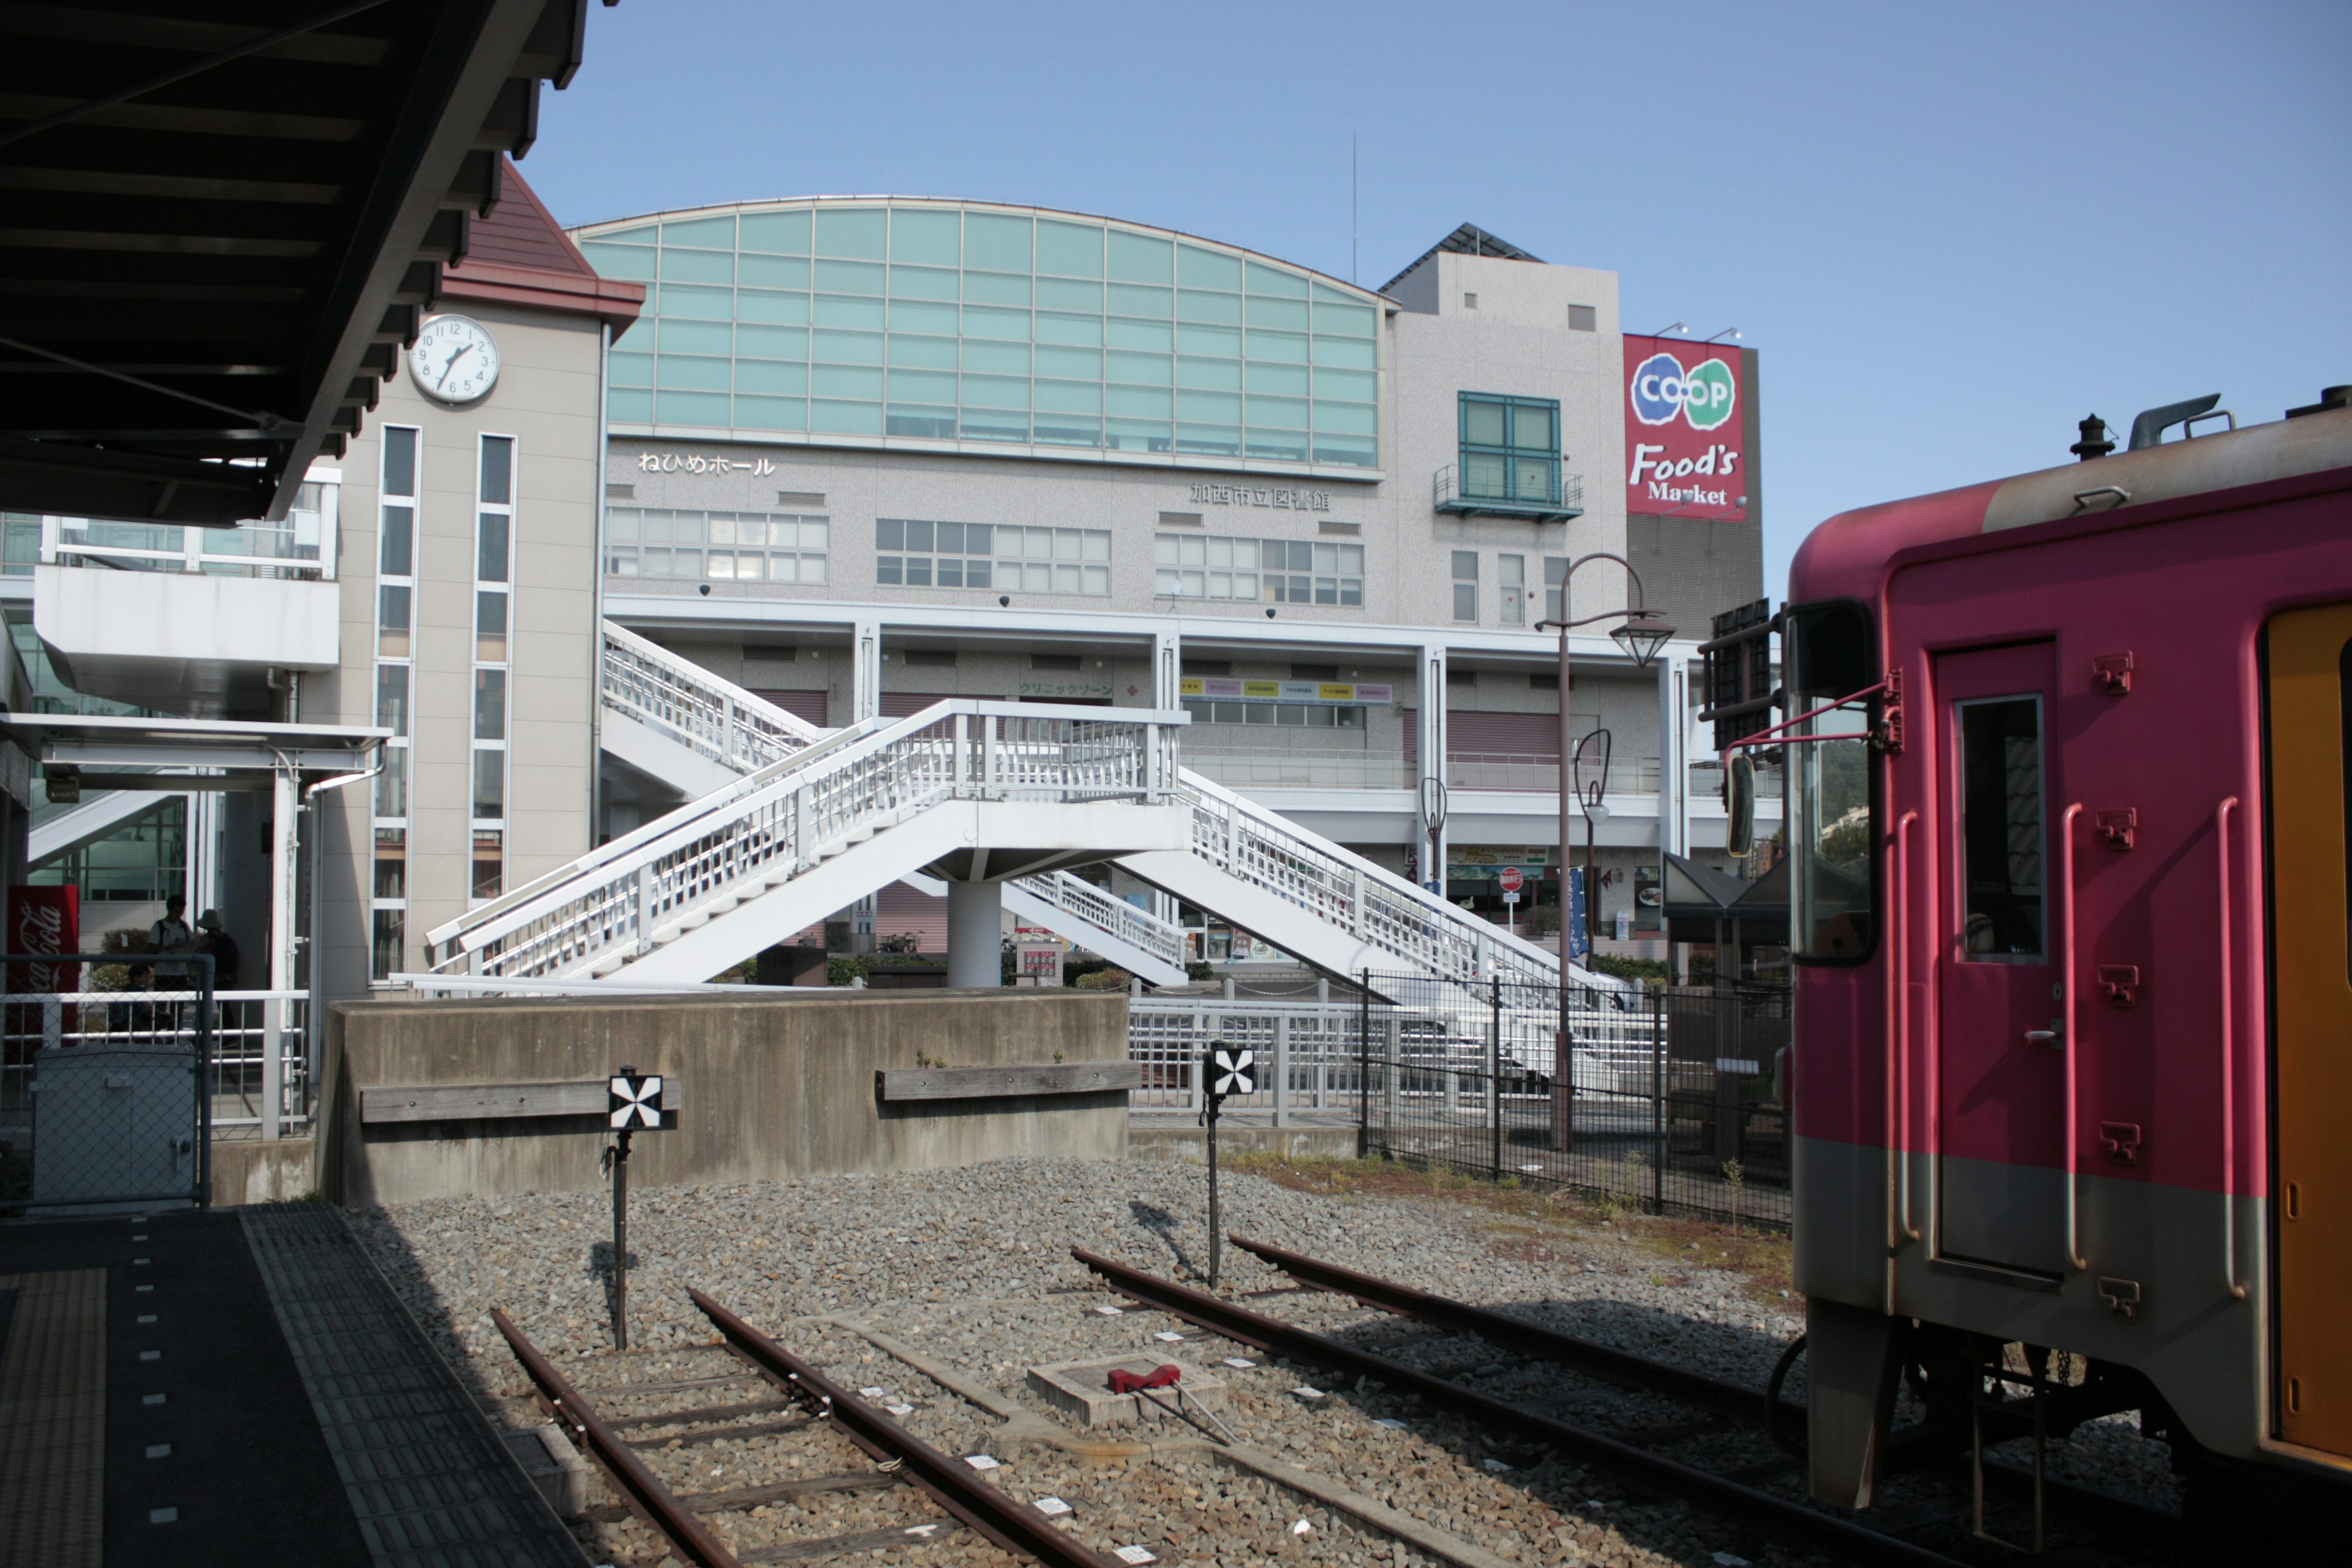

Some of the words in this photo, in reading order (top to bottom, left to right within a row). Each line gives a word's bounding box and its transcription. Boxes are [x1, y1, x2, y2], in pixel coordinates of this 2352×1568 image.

[437, 326, 443, 337] 11
[451, 323, 460, 335] 12
[424, 336, 432, 347] 10
[478, 342, 484, 352] 2
[420, 350, 426, 360] 9
[481, 356, 488, 366] 3
[423, 365, 429, 375] 8
[476, 371, 484, 381] 4
[450, 382, 456, 393] 6
[464, 380, 470, 391] 5
[638, 451, 776, 476] ねひめホール
[1629, 443, 1739, 484] Food's
[1191, 481, 1332, 511] 加西市立図書館
